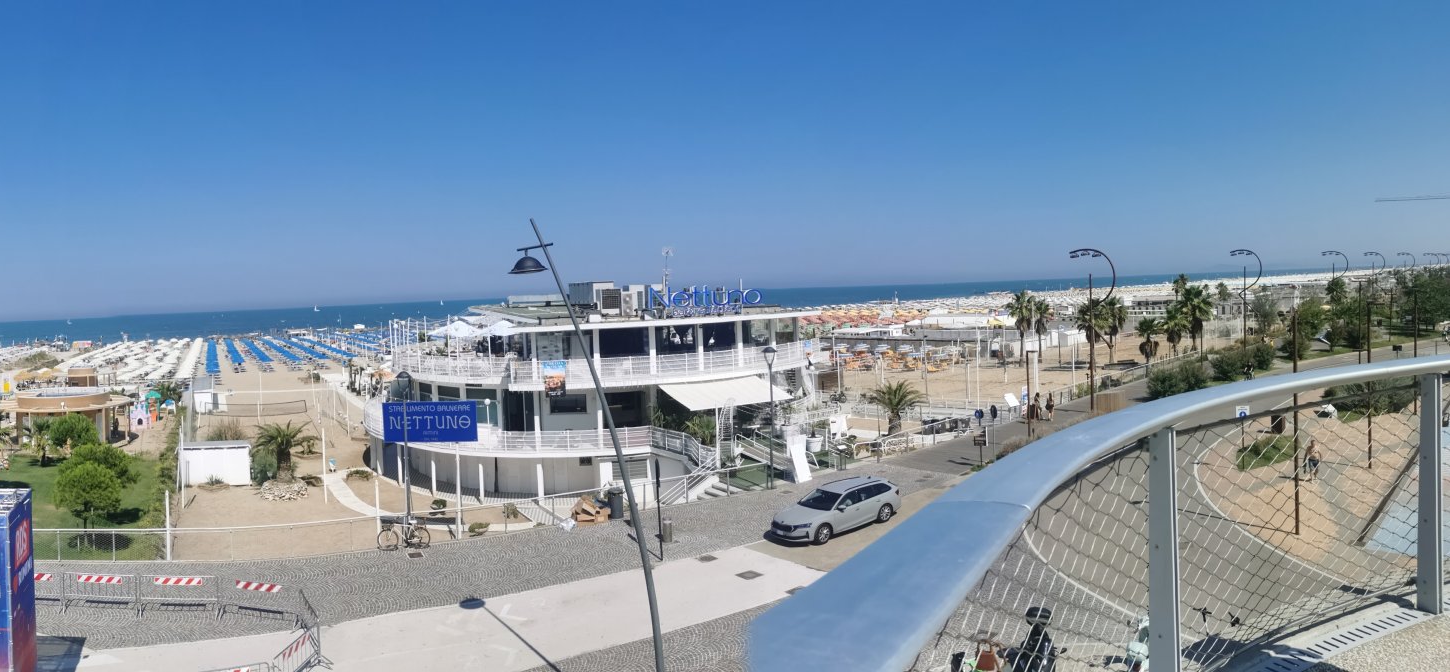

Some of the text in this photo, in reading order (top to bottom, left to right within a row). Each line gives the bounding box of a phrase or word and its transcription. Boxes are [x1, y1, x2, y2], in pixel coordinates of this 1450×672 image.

[648, 284, 762, 308] Nettuno
[389, 414, 471, 430] NETTUNO
[15, 520, 28, 562] RDS
